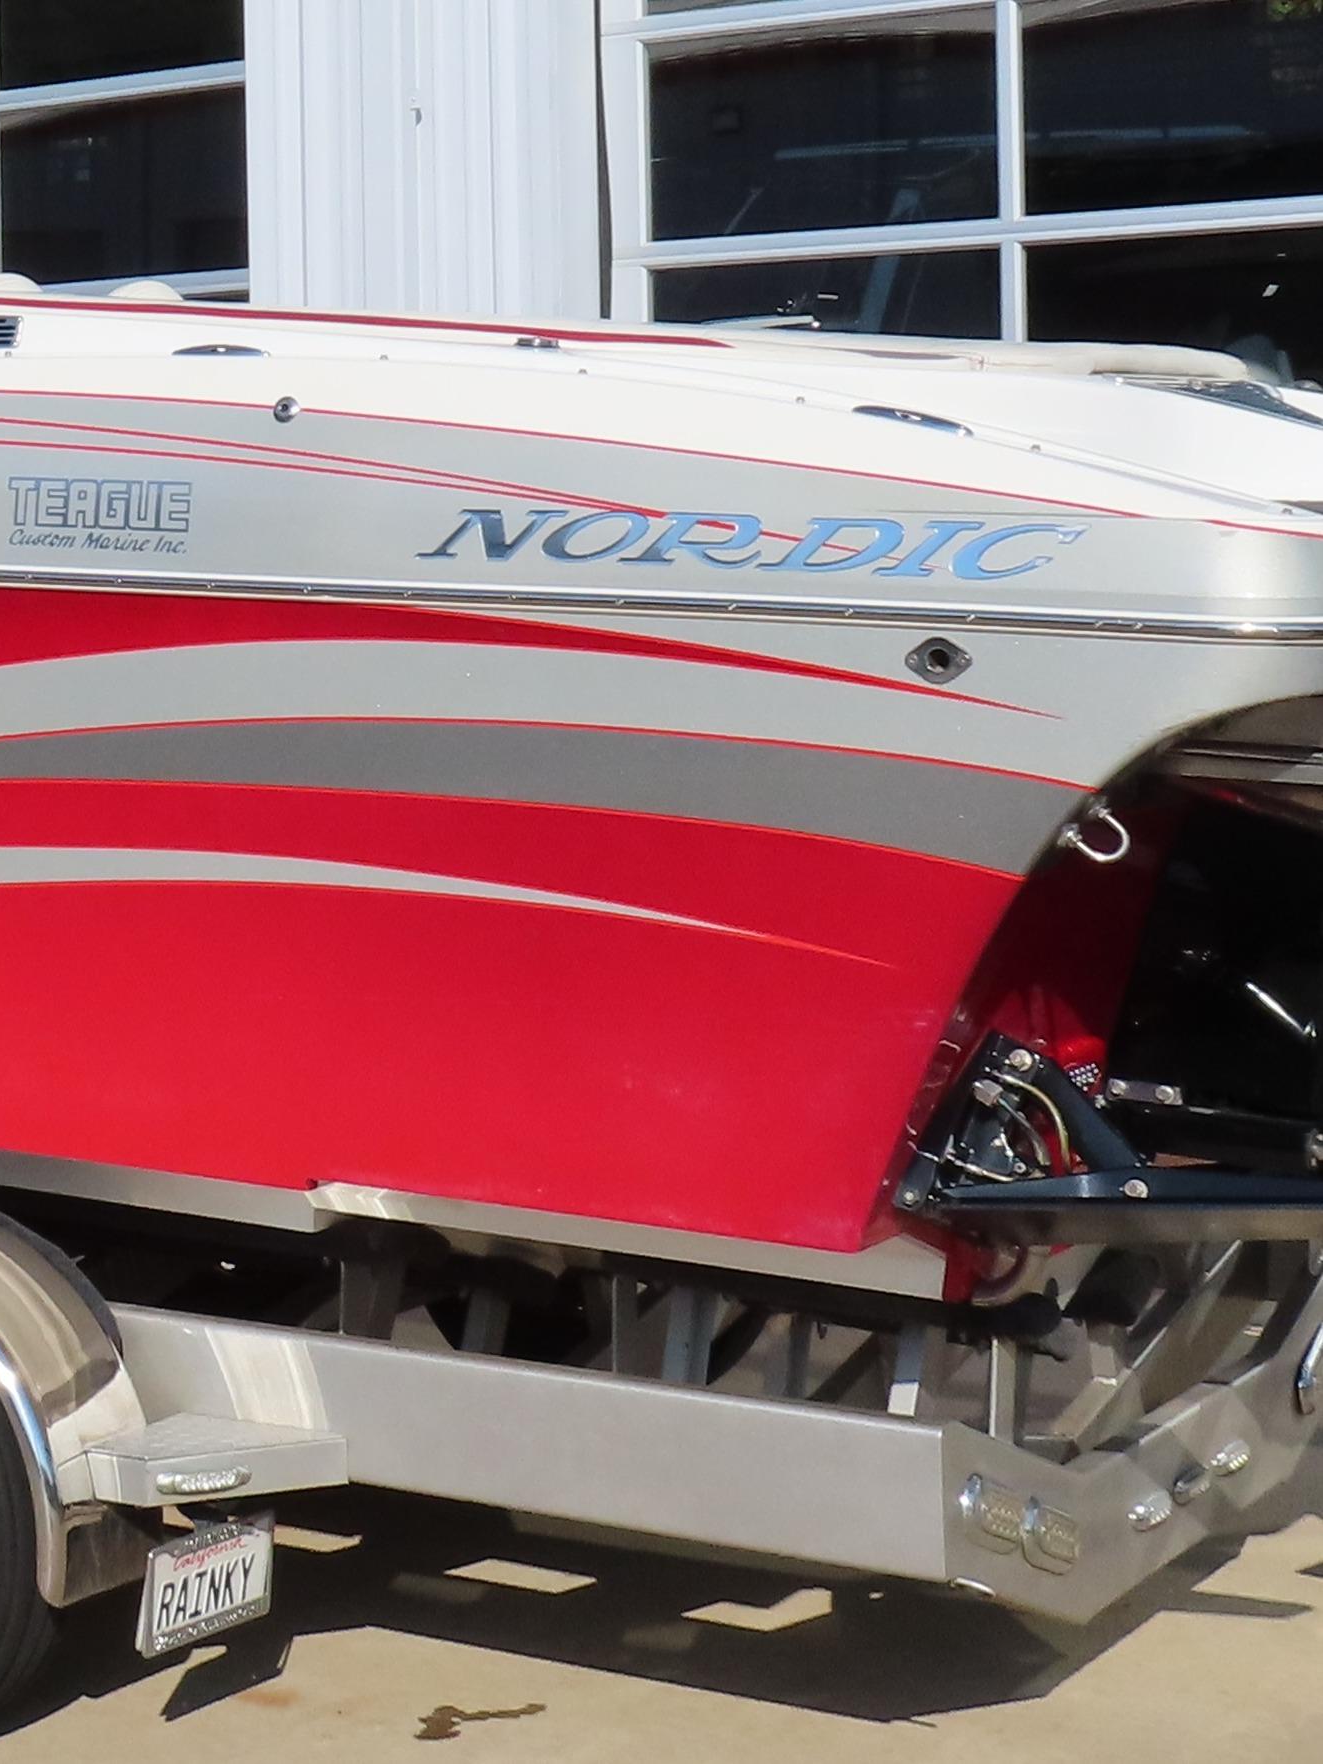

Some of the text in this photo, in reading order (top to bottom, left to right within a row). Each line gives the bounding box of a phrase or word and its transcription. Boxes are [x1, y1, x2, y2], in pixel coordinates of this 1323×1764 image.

[8, 476, 192, 532] TEAGUE
[8, 528, 188, 555] Custom Marine Inc.
[415, 507, 1089, 580] NORDIC
[156, 1552, 255, 1632] RAINKY
